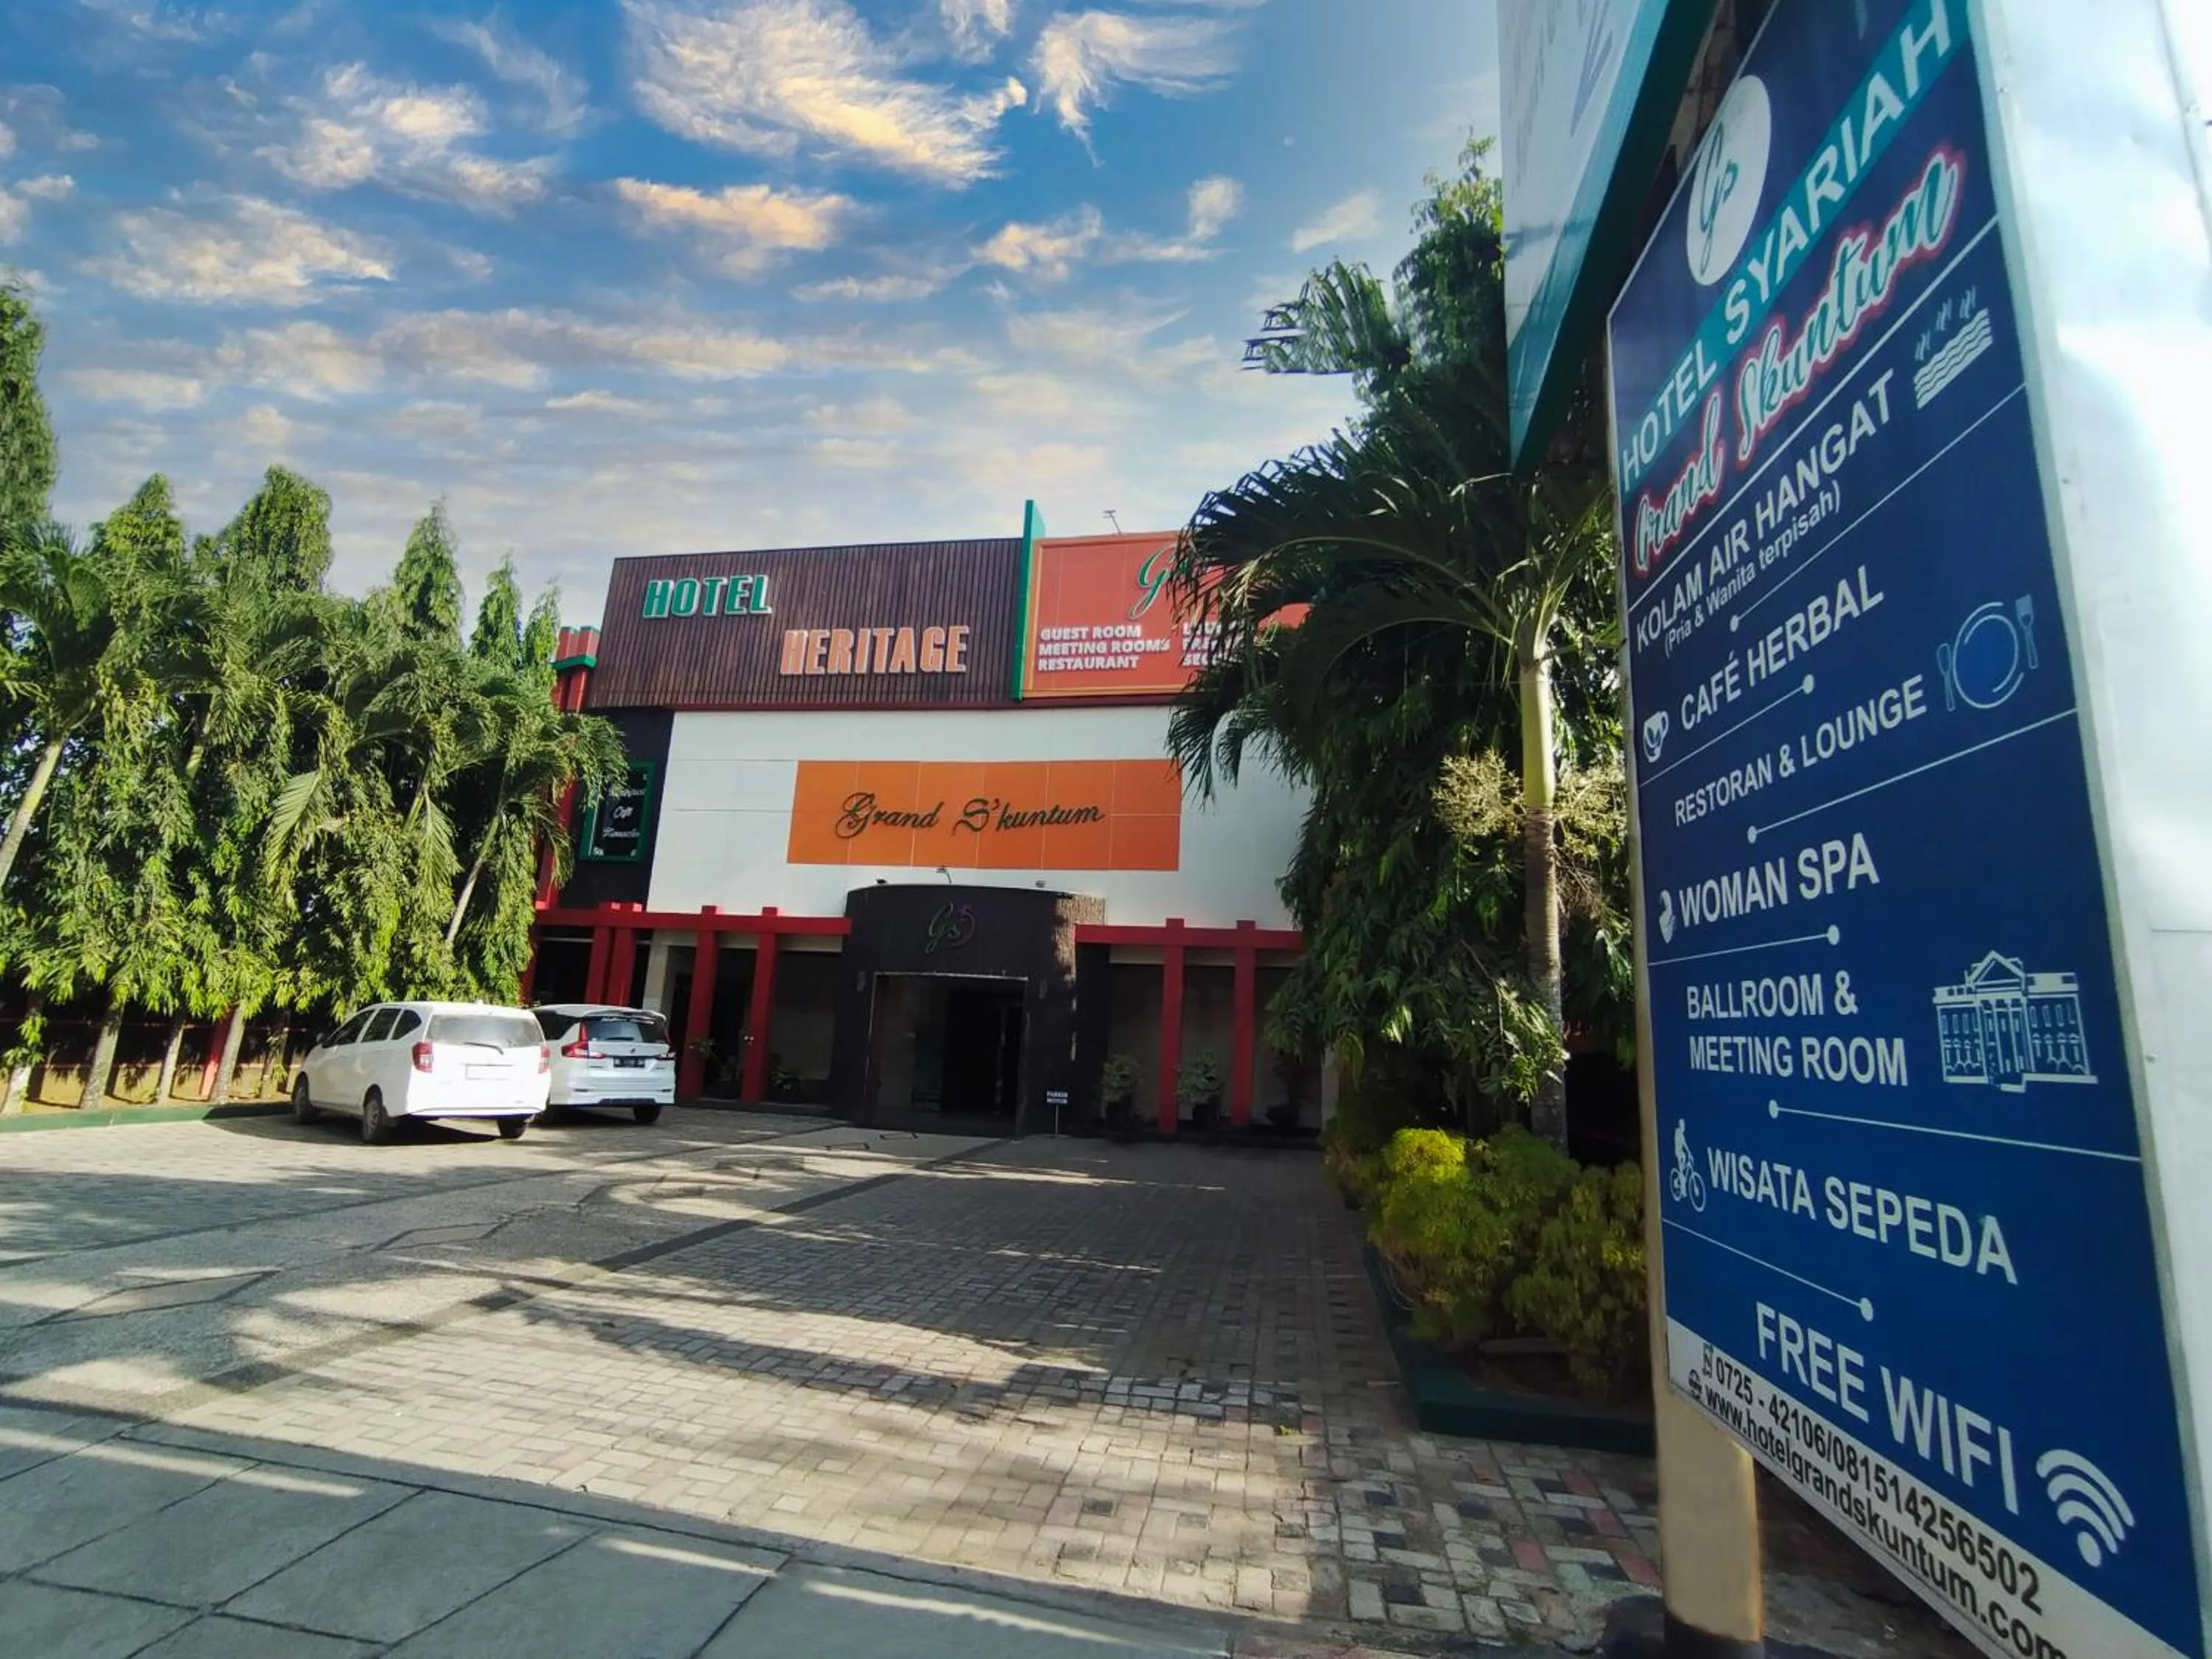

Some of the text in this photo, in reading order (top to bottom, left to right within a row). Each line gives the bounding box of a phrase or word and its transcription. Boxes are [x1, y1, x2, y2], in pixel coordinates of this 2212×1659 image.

[1623, 0, 1951, 493] HOTEL SYARIAH
[1636, 368, 1894, 653] KOLAM AIR HANGAT
[641, 574, 773, 619] HOTEL
[1664, 480, 1841, 659] (Pria & Wanita terpisah)
[779, 625, 970, 675] HERITAGE
[1037, 655, 1140, 672] RESTAURANT
[1038, 639, 1171, 656] MEETING ROOMS
[1040, 625, 1142, 641] GUEST ROOM
[1681, 565, 1885, 730] CAFÉ HERBAL
[1674, 673, 1928, 827] RESTORAN & LOUNGE
[835, 791, 945, 840] Grand
[1678, 832, 1881, 929] WOMAN SPA
[1686, 969, 1859, 1020] BALLROOM &
[1688, 1034, 1910, 1088] MEETING ROOM
[1705, 1146, 2019, 1286] WISATA SEPEDA
[1755, 1300, 2020, 1516] FREE WIFI
[1715, 1356, 1753, 1406] 0725
[1769, 1393, 2042, 1618] 42106/081514256502
